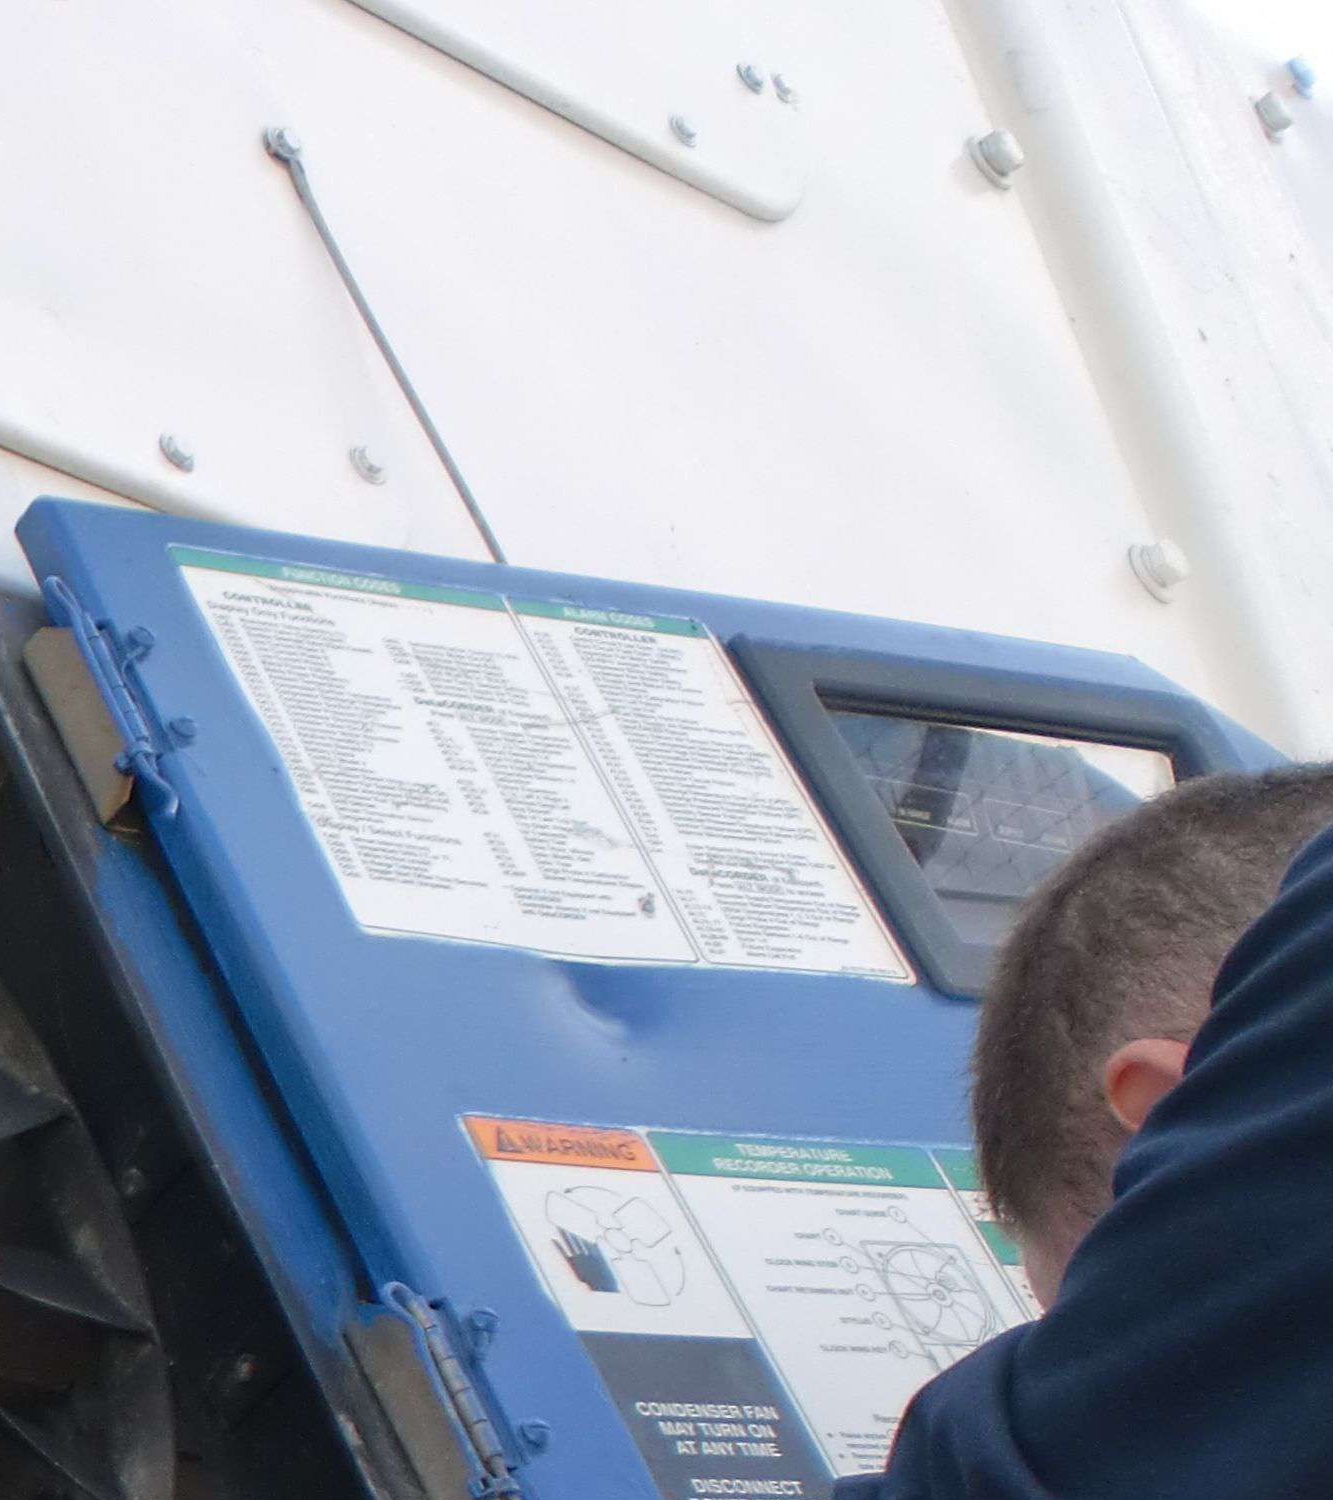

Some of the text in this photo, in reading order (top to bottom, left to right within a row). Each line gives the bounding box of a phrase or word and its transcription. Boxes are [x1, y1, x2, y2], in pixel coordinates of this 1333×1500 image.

[518, 1133, 637, 1162] WARNING
[735, 1143, 854, 1163] TEMPERATURE
[712, 1157, 894, 1181] RECORDER OPERATION
[635, 1401, 780, 1420] CONDENSER FAN
[658, 1421, 777, 1438] MAY TURN ON
[676, 1440, 782, 1457] AT ANY TIME
[690, 1478, 804, 1495] DISCONNECT
